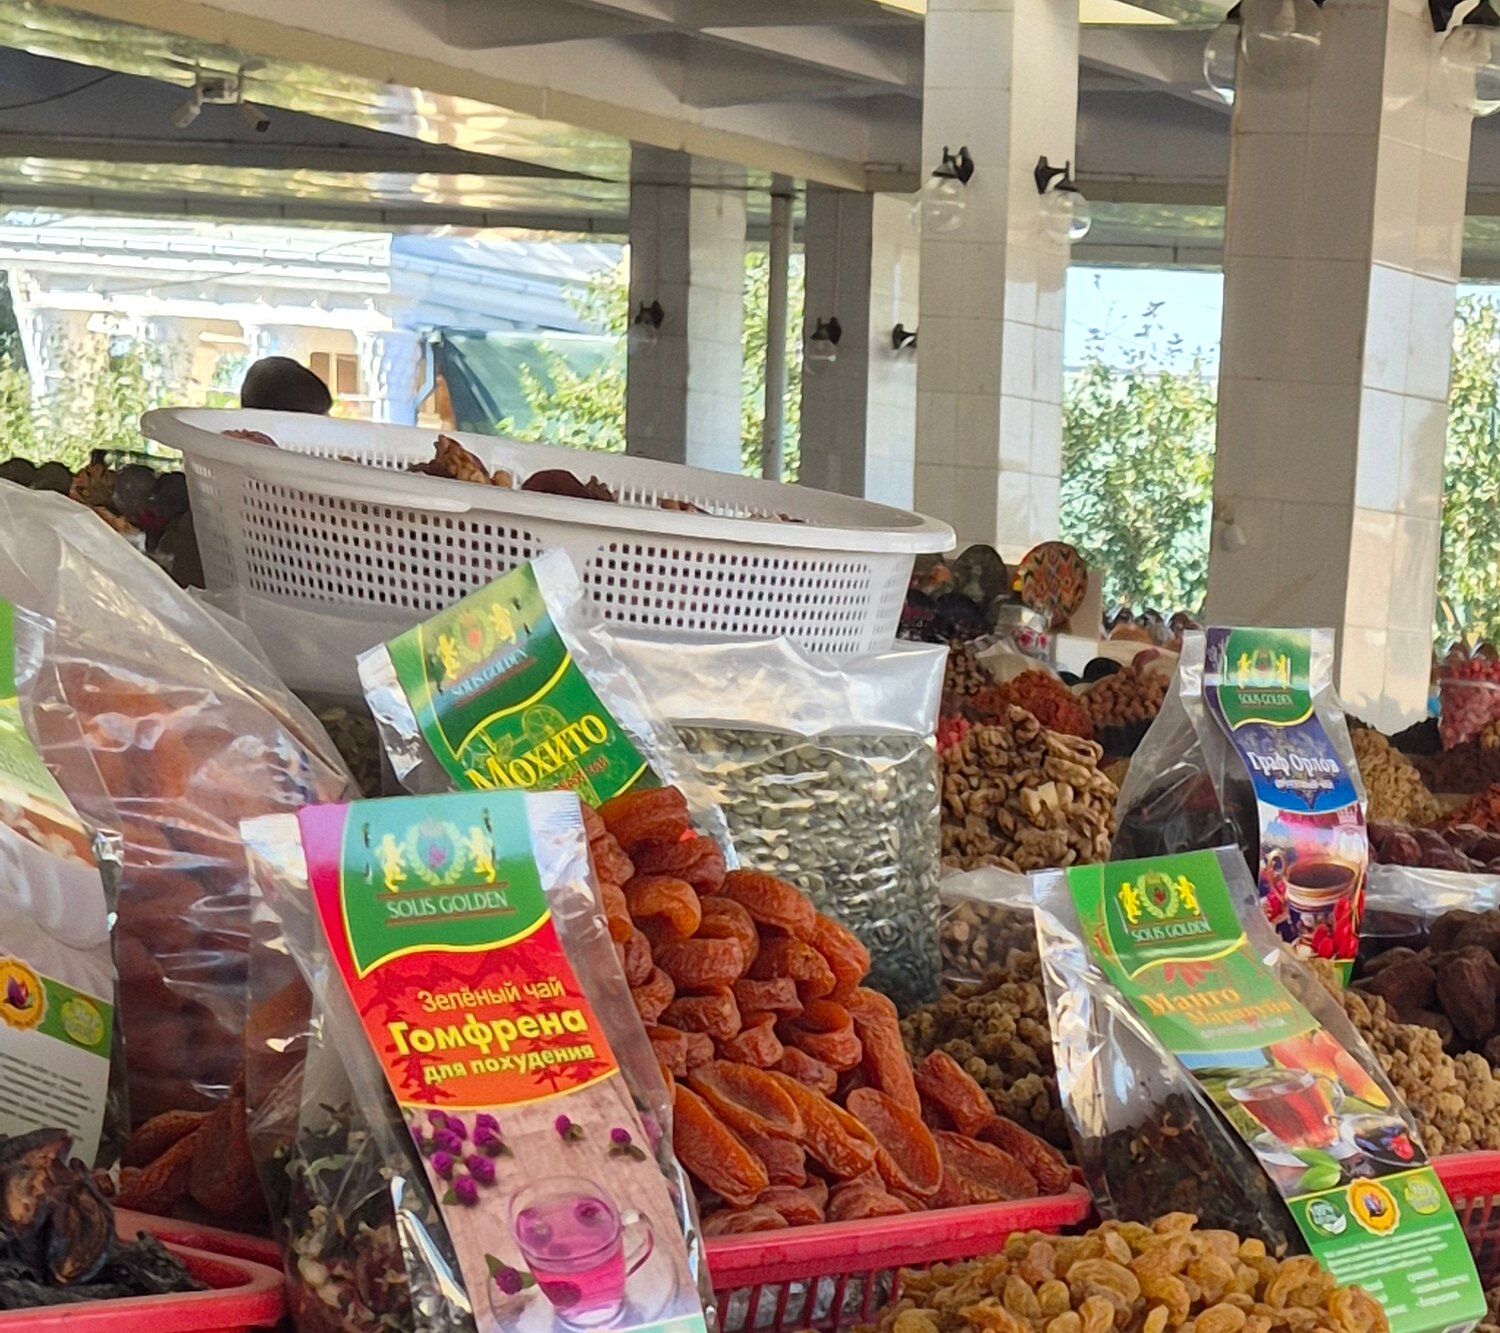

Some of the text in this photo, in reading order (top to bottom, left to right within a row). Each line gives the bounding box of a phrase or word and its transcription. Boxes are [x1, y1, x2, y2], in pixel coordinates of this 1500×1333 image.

[1246, 751, 1340, 777] Граф Орлов
[387, 890, 508, 919] SOLIS GOLDEN
[1131, 921, 1211, 942] SOLIS GOLDEN
[417, 976, 566, 1014] Зелёный чай
[1139, 989, 1240, 1016] Манго
[388, 1009, 589, 1056] Гомфрена
[423, 1044, 596, 1085] для похудения
